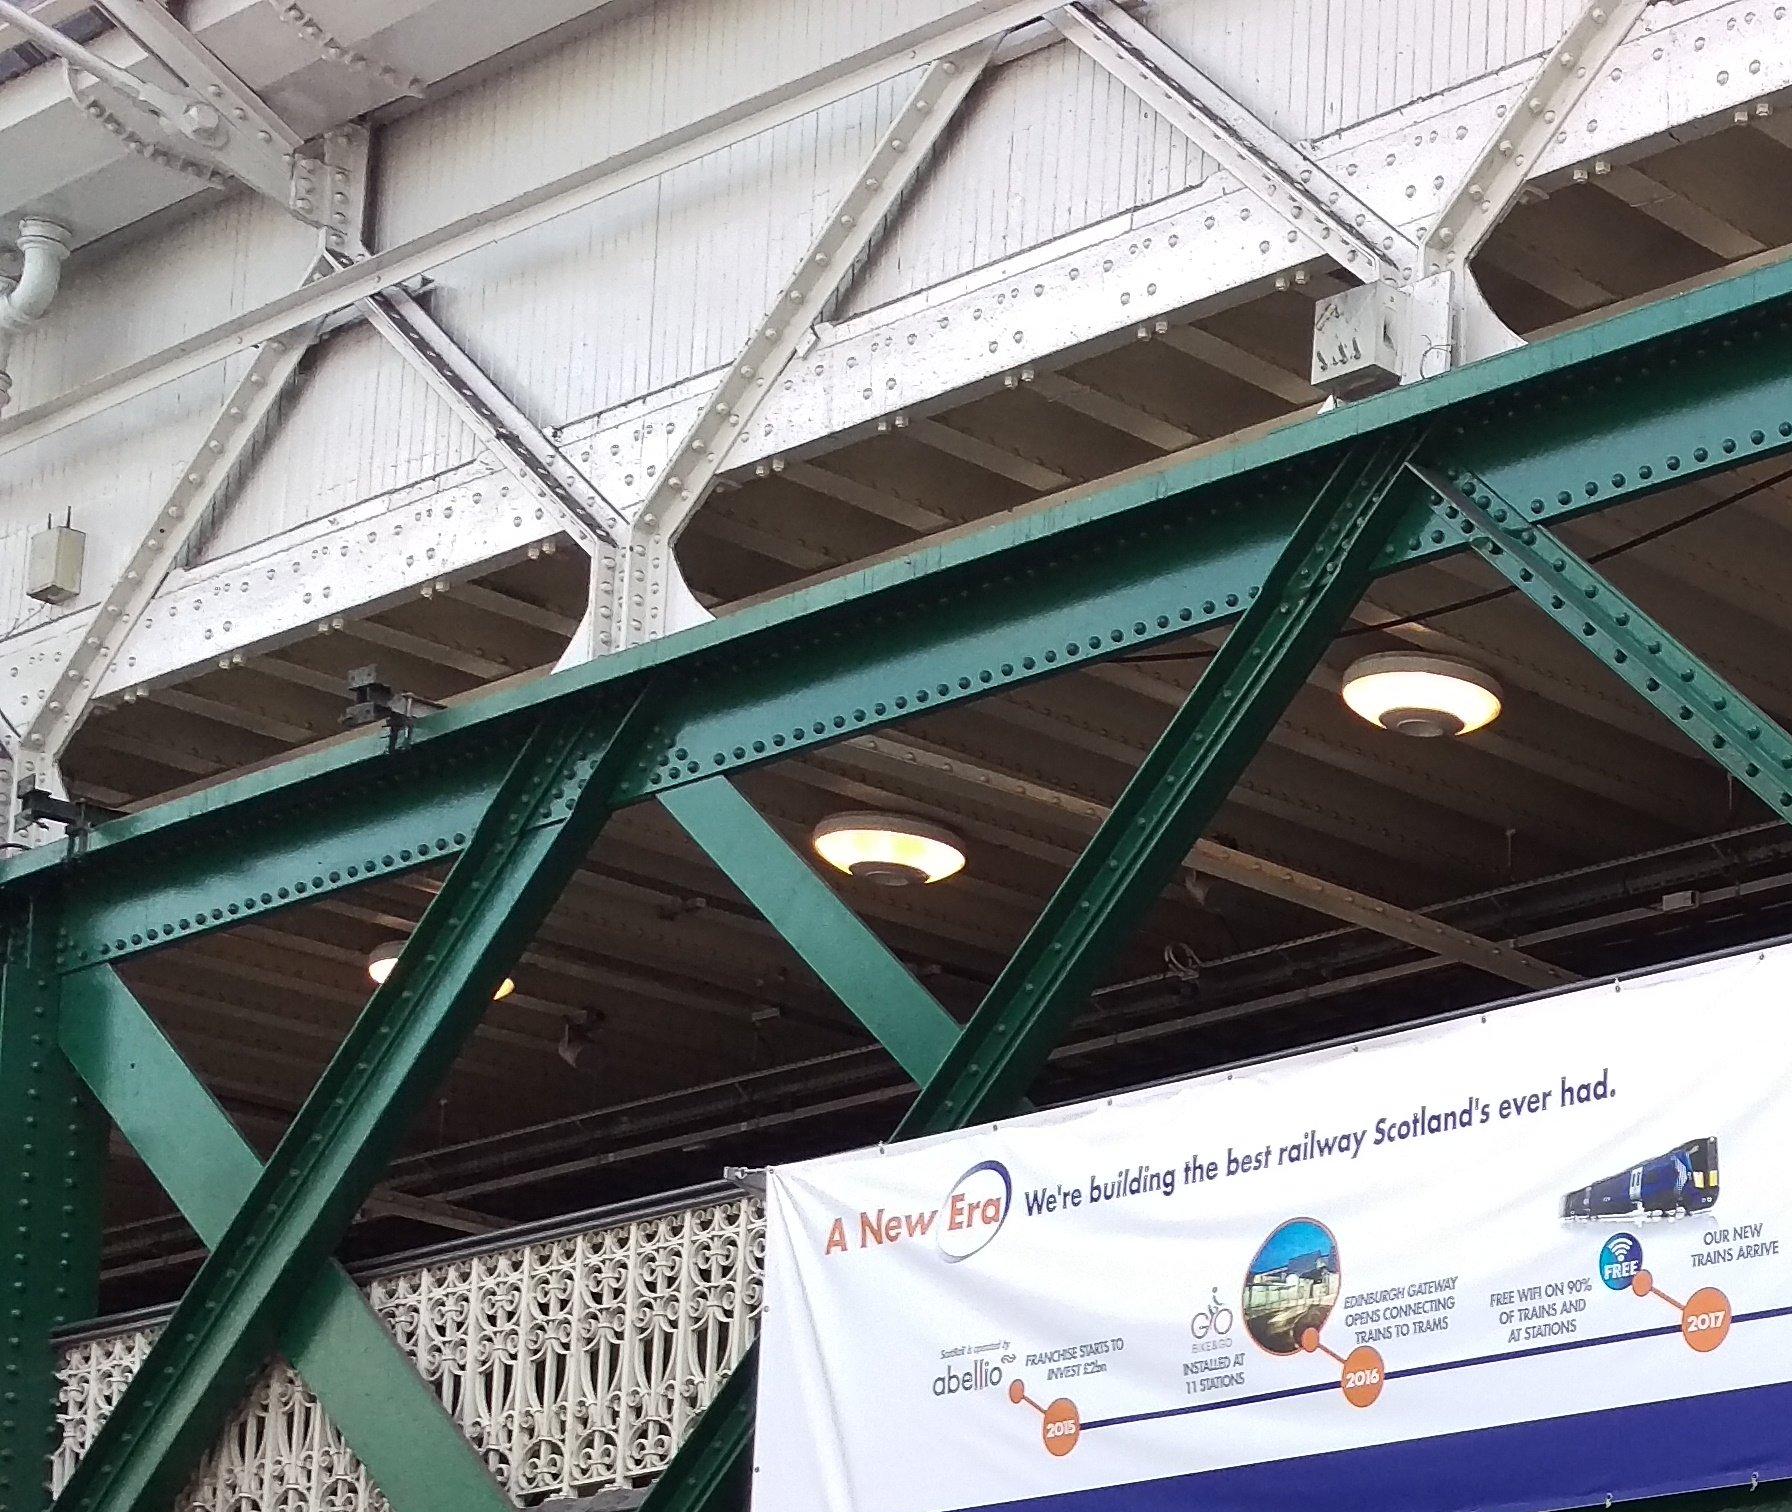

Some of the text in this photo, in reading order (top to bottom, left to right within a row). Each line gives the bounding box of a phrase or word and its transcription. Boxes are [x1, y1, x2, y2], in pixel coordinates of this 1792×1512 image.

[1025, 1069, 1617, 1216] We're building the best railway Scotland's ever had.
[826, 1193, 1002, 1255] A New Era
[1703, 1223, 1764, 1246] OUR NEW
[1690, 1240, 1780, 1268] TRAINS ARRIVE
[1603, 1260, 1641, 1280] FREE
[1343, 1276, 1458, 1310] EDINBURGH GATEWAY
[1490, 1278, 1593, 1307] FREE WIFI ON 90%
[1344, 1296, 1455, 1328] OPENS CONNECTING
[1499, 1298, 1587, 1325] OF TRAINS AND
[1687, 1310, 1726, 1333] 2017
[1355, 1316, 1449, 1345] TRAINS TO TRAMS
[1507, 1319, 1577, 1344] AT STATIONS
[1025, 1338, 1124, 1367] FRANCHISE STARTS TO
[1182, 1353, 1246, 1377] INSTALLED AT
[933, 1359, 1002, 1396] abellio
[1047, 1364, 1082, 1380] INVEST
[1199, 1372, 1245, 1393] STATIONS
[1345, 1372, 1380, 1389] 2016
[1046, 1419, 1076, 1438] 2015
